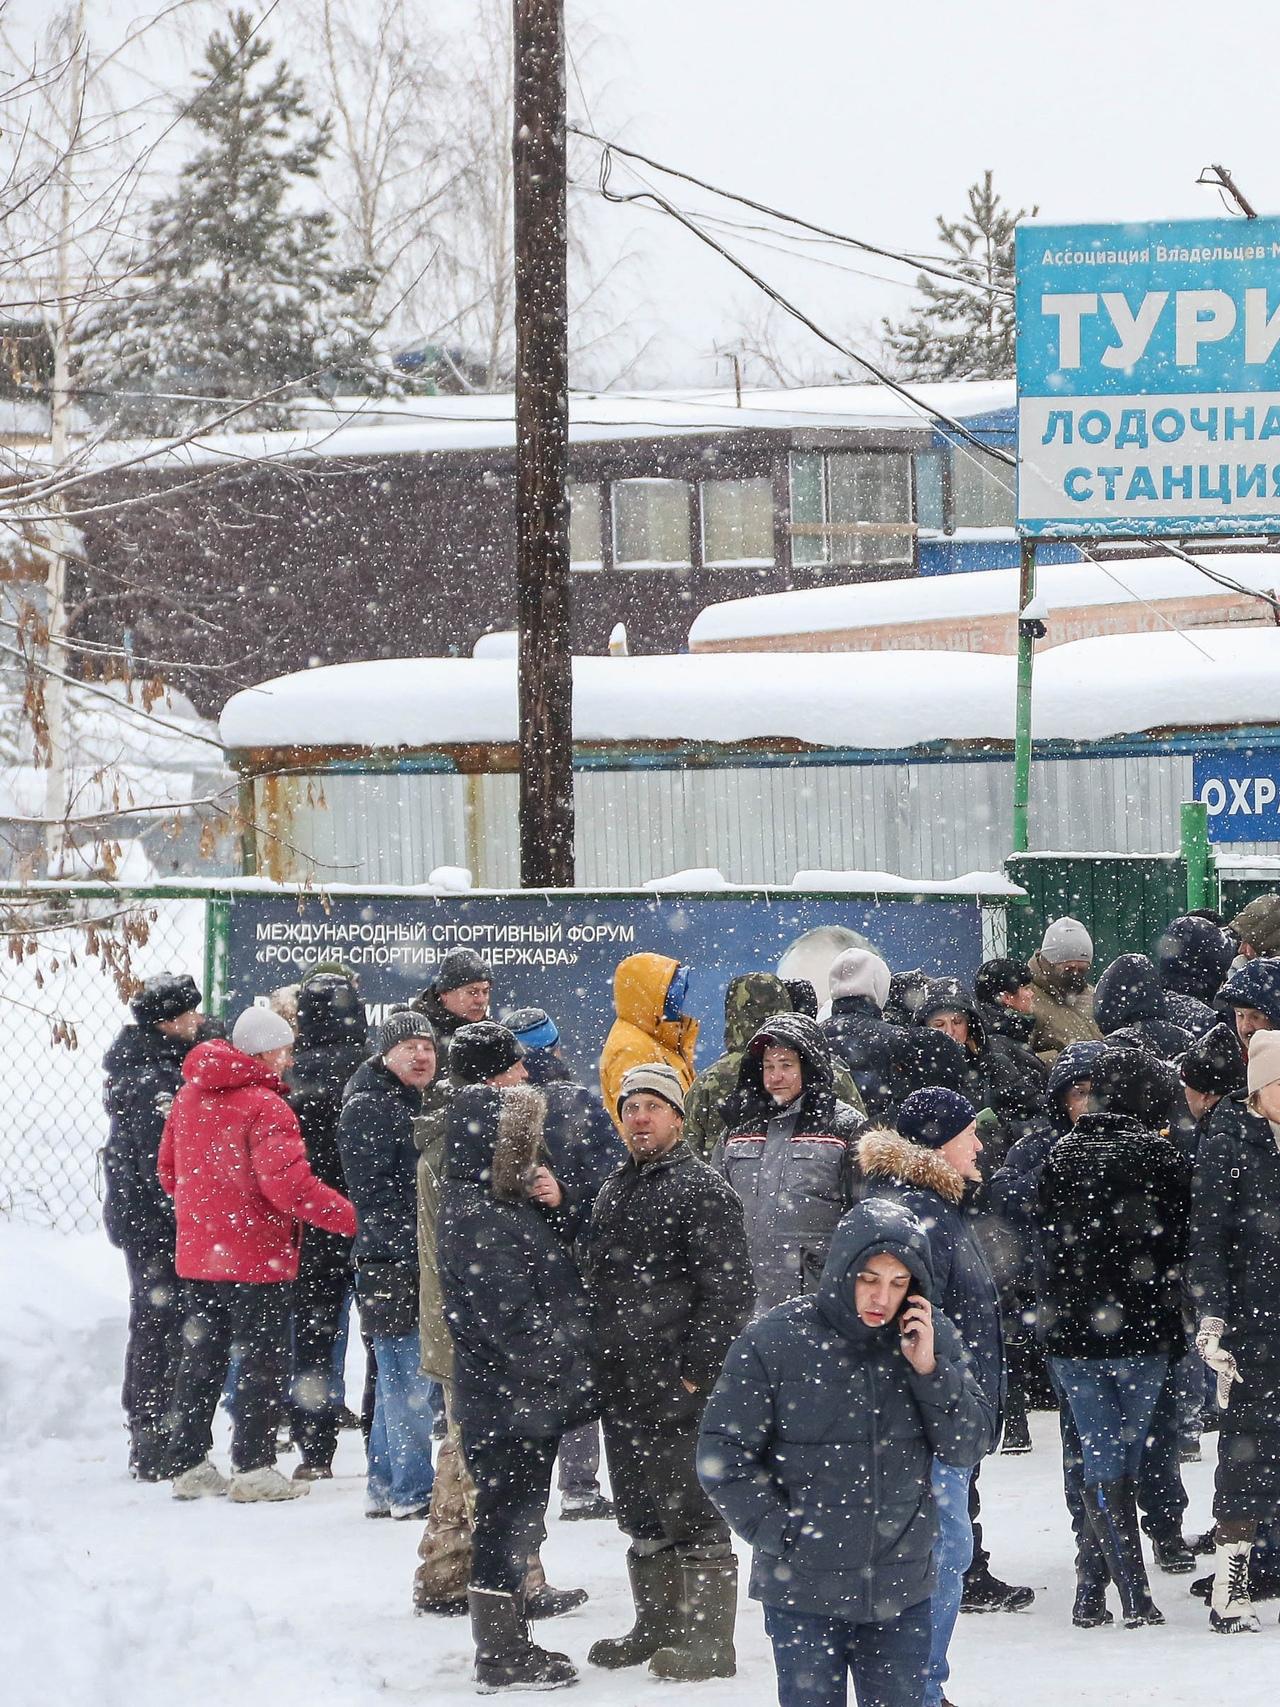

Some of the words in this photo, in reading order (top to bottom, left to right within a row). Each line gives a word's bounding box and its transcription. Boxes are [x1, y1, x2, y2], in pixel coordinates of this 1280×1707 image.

[1042, 248, 1150, 265] Ассоциация
[1156, 244, 1265, 263] Владельцев
[256, 922, 427, 943] МЕЖДУНАРОДНЫЙ
[432, 923, 562, 942] СПОРТИВНЫЙ
[568, 925, 634, 942] ФОРУМ
[255, 946, 449, 964] «РОССИЯ-СПОРТИВН
